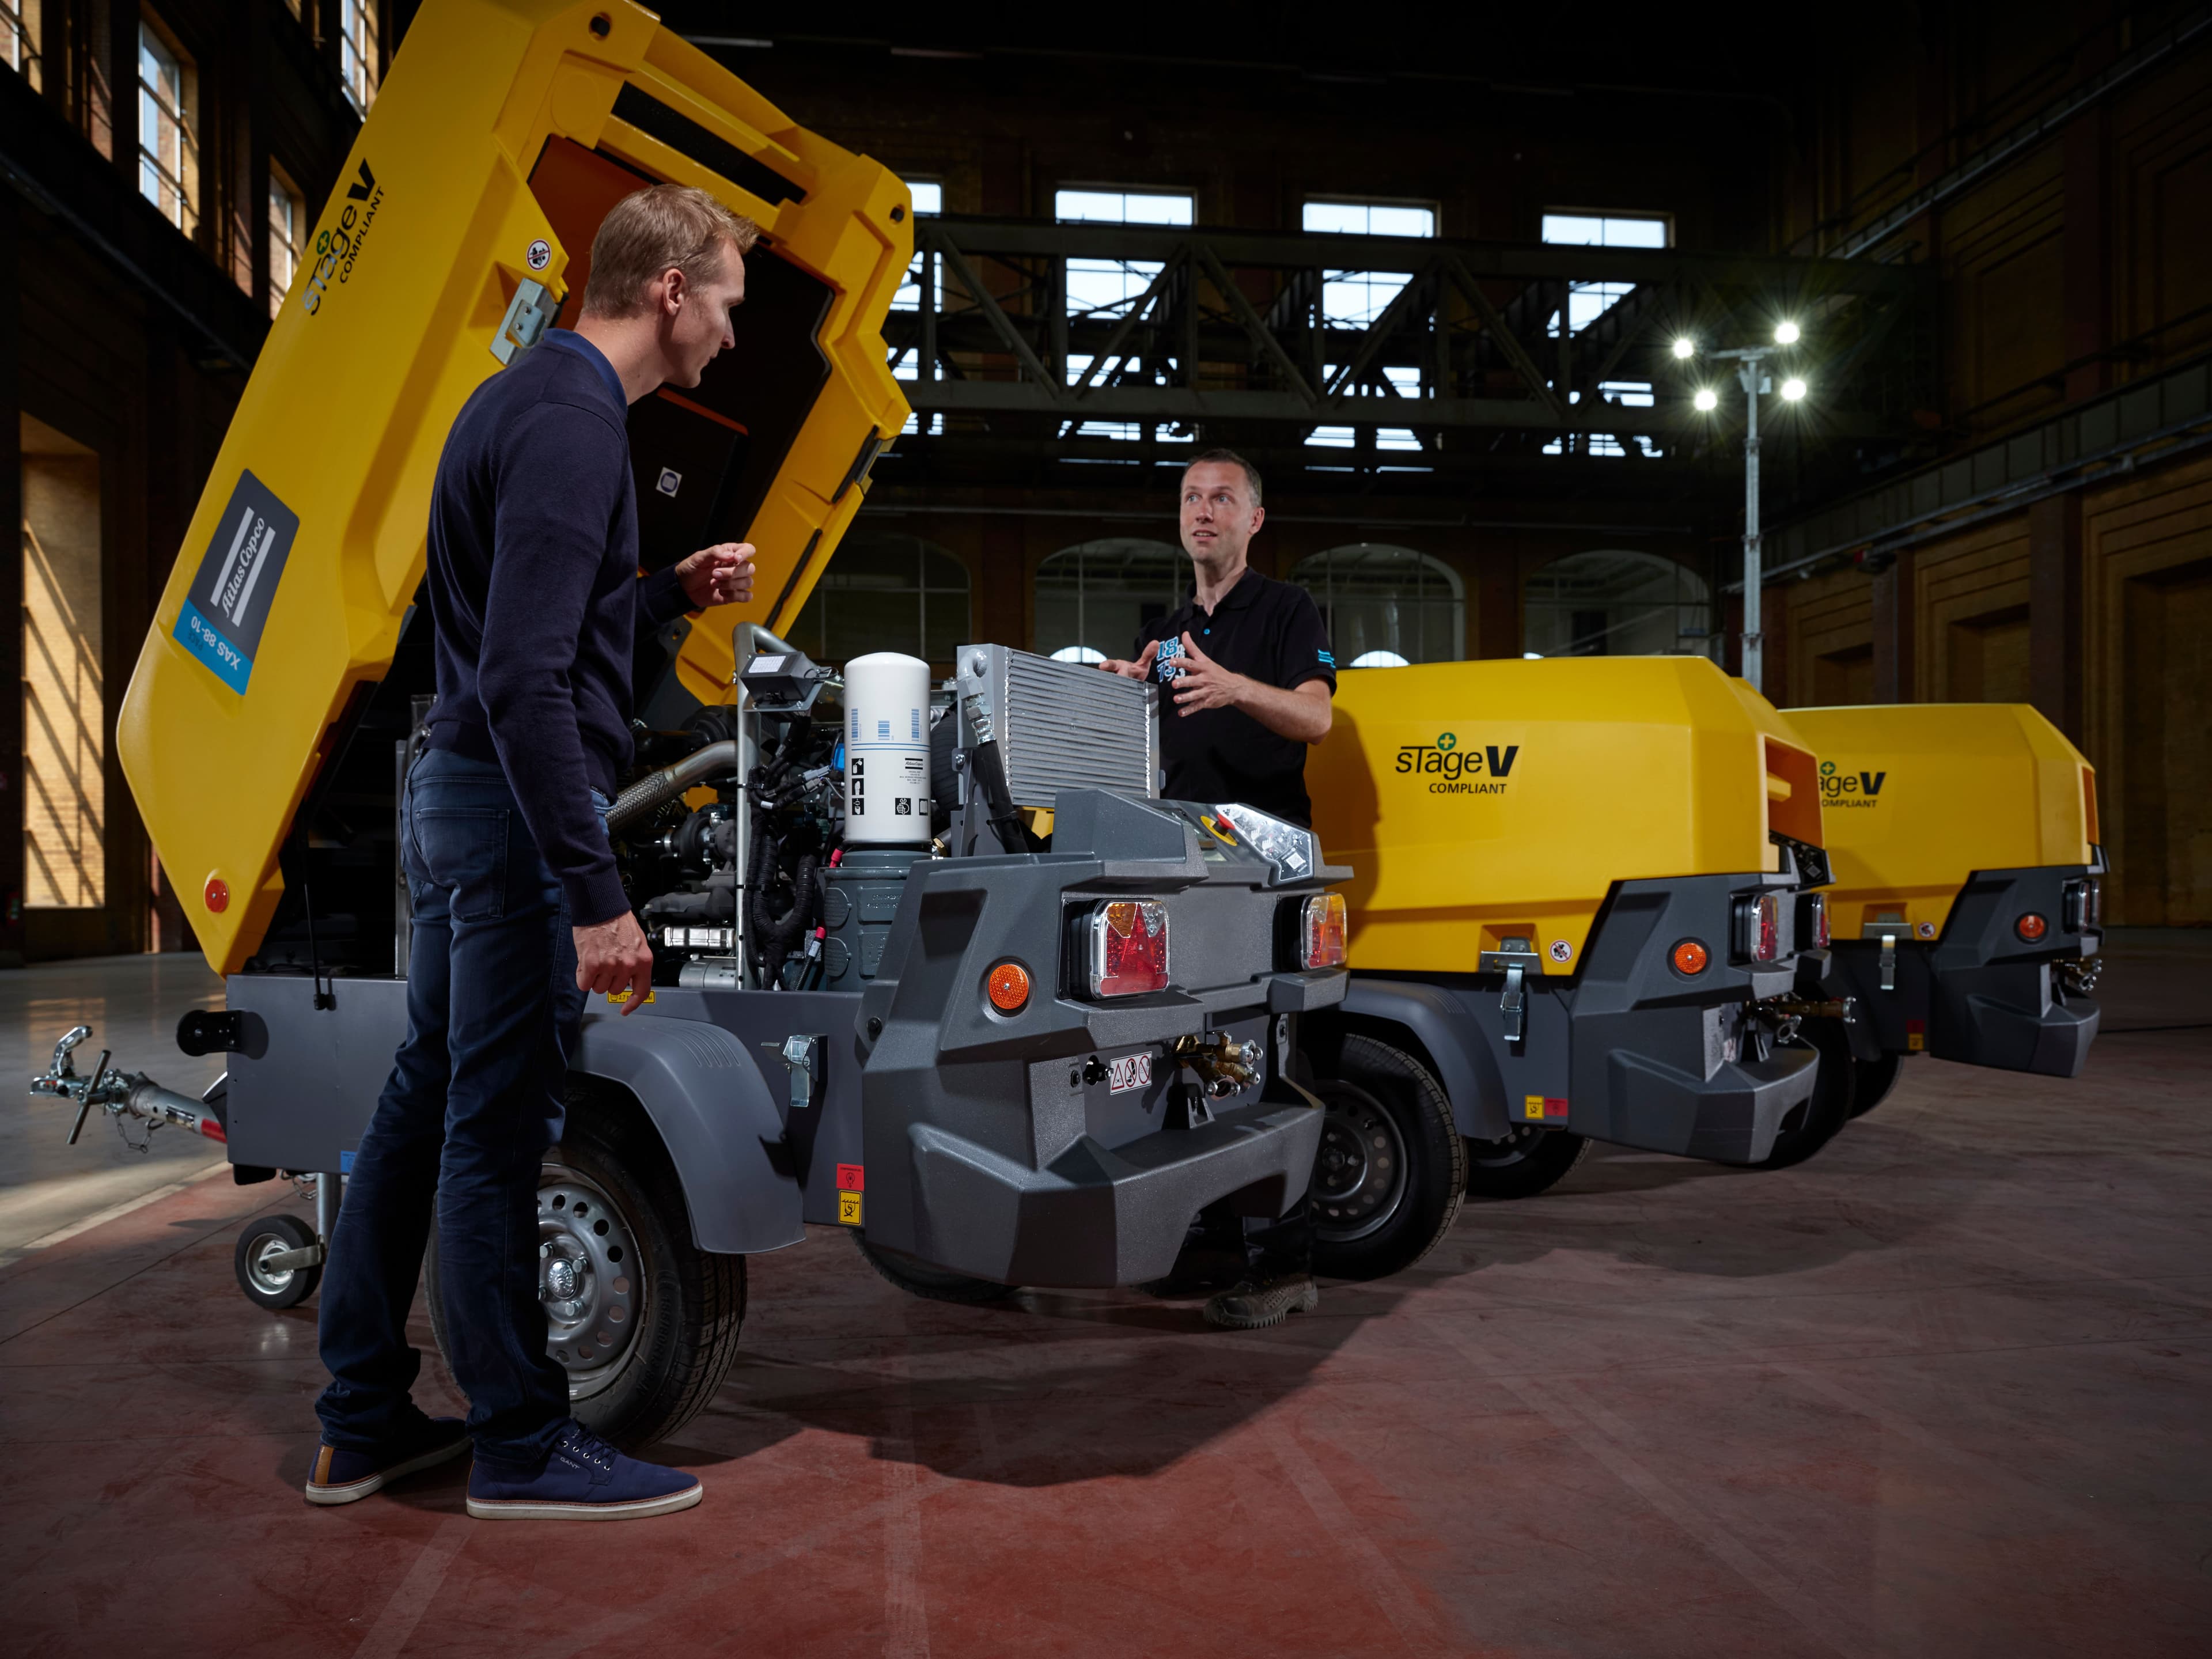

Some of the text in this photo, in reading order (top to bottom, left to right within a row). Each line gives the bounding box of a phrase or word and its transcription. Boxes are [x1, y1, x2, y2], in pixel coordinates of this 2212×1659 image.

[347, 157, 376, 202] V
[339, 186, 385, 283] COMPLIANT
[222, 517, 265, 618] Atlas Copco
[191, 616, 241, 671] XAS 88-10
[1157, 636, 1179, 661] 18
[1486, 745, 1520, 777] V
[1429, 783, 1508, 794] COMPLIANT
[1859, 772, 1887, 796] V
[1822, 799, 1878, 808] OMPLIANT
[560, 1457, 580, 1469] GANT
